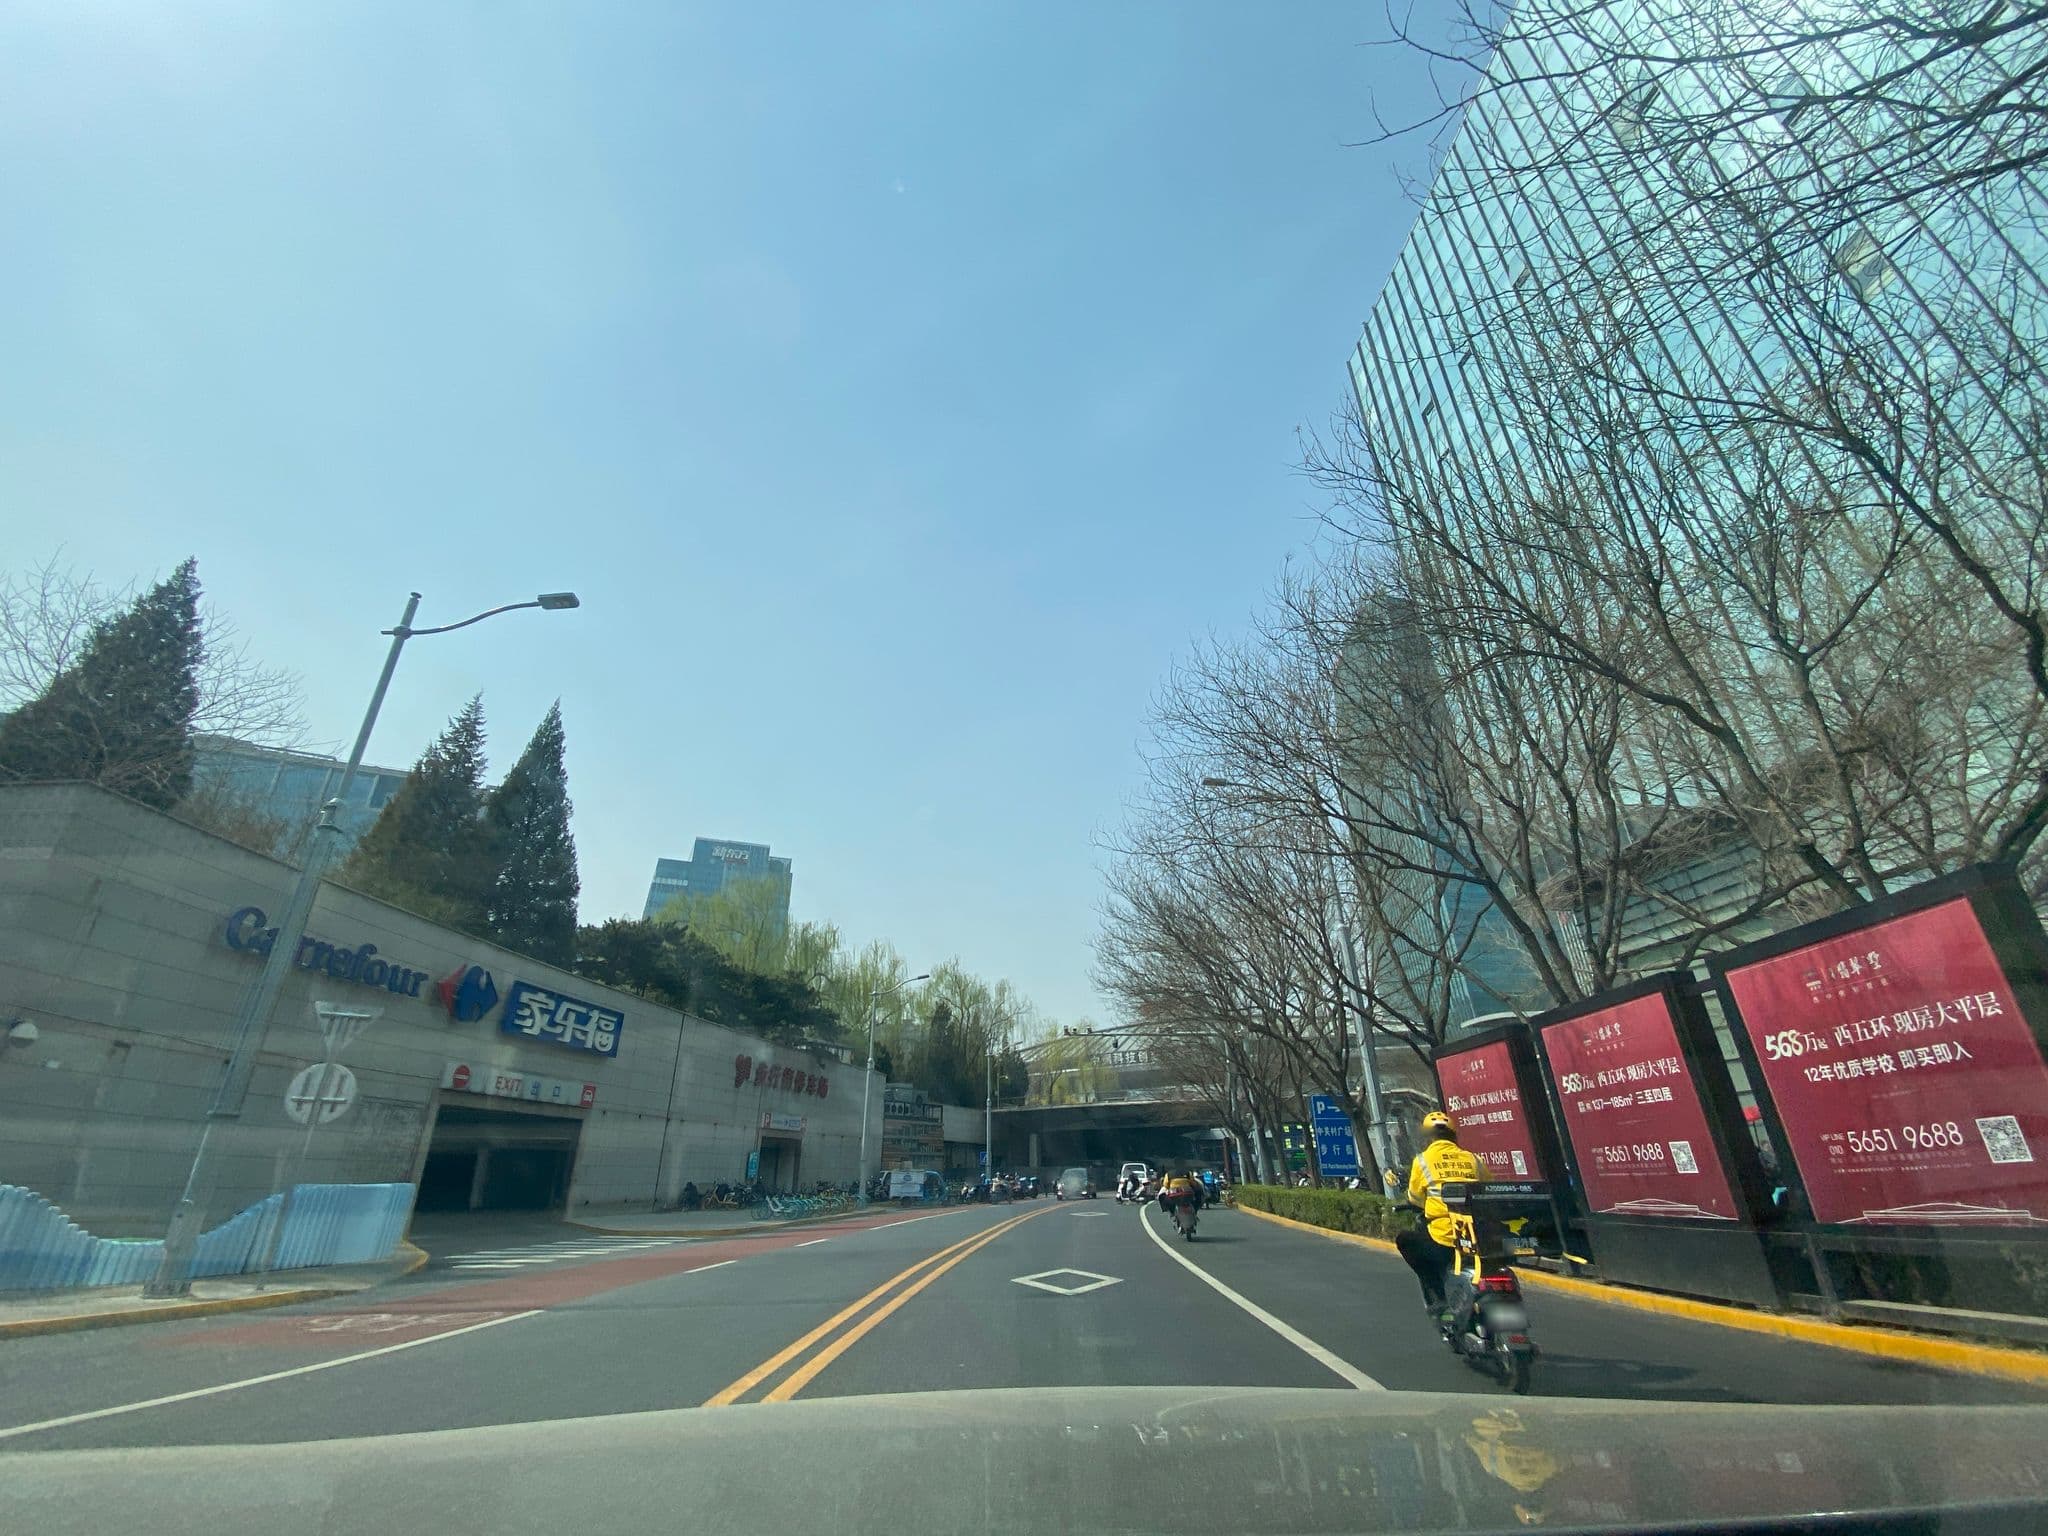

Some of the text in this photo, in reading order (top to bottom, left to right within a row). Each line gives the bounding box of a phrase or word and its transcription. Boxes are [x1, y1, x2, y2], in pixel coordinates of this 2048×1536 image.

[226, 907, 429, 997] Carrefour
[514, 991, 618, 1052] 家乐福
[1765, 992, 2003, 1060] 568万起 西五环 现房大平层
[1597, 1067, 1626, 1087] 西五环
[1627, 1057, 1681, 1081] 现房大平层
[1805, 1041, 1973, 1083] 12年优质学校 即买即入
[496, 1076, 521, 1093] EXIT
[1635, 1087, 1673, 1105] 三至四居
[1316, 1101, 1325, 1115] P
[1604, 1145, 1631, 1162] 5651
[1632, 1142, 1664, 1162] 9688
[1847, 1121, 1963, 1153] 5651 9688
[1490, 1151, 1509, 1165] 9688
